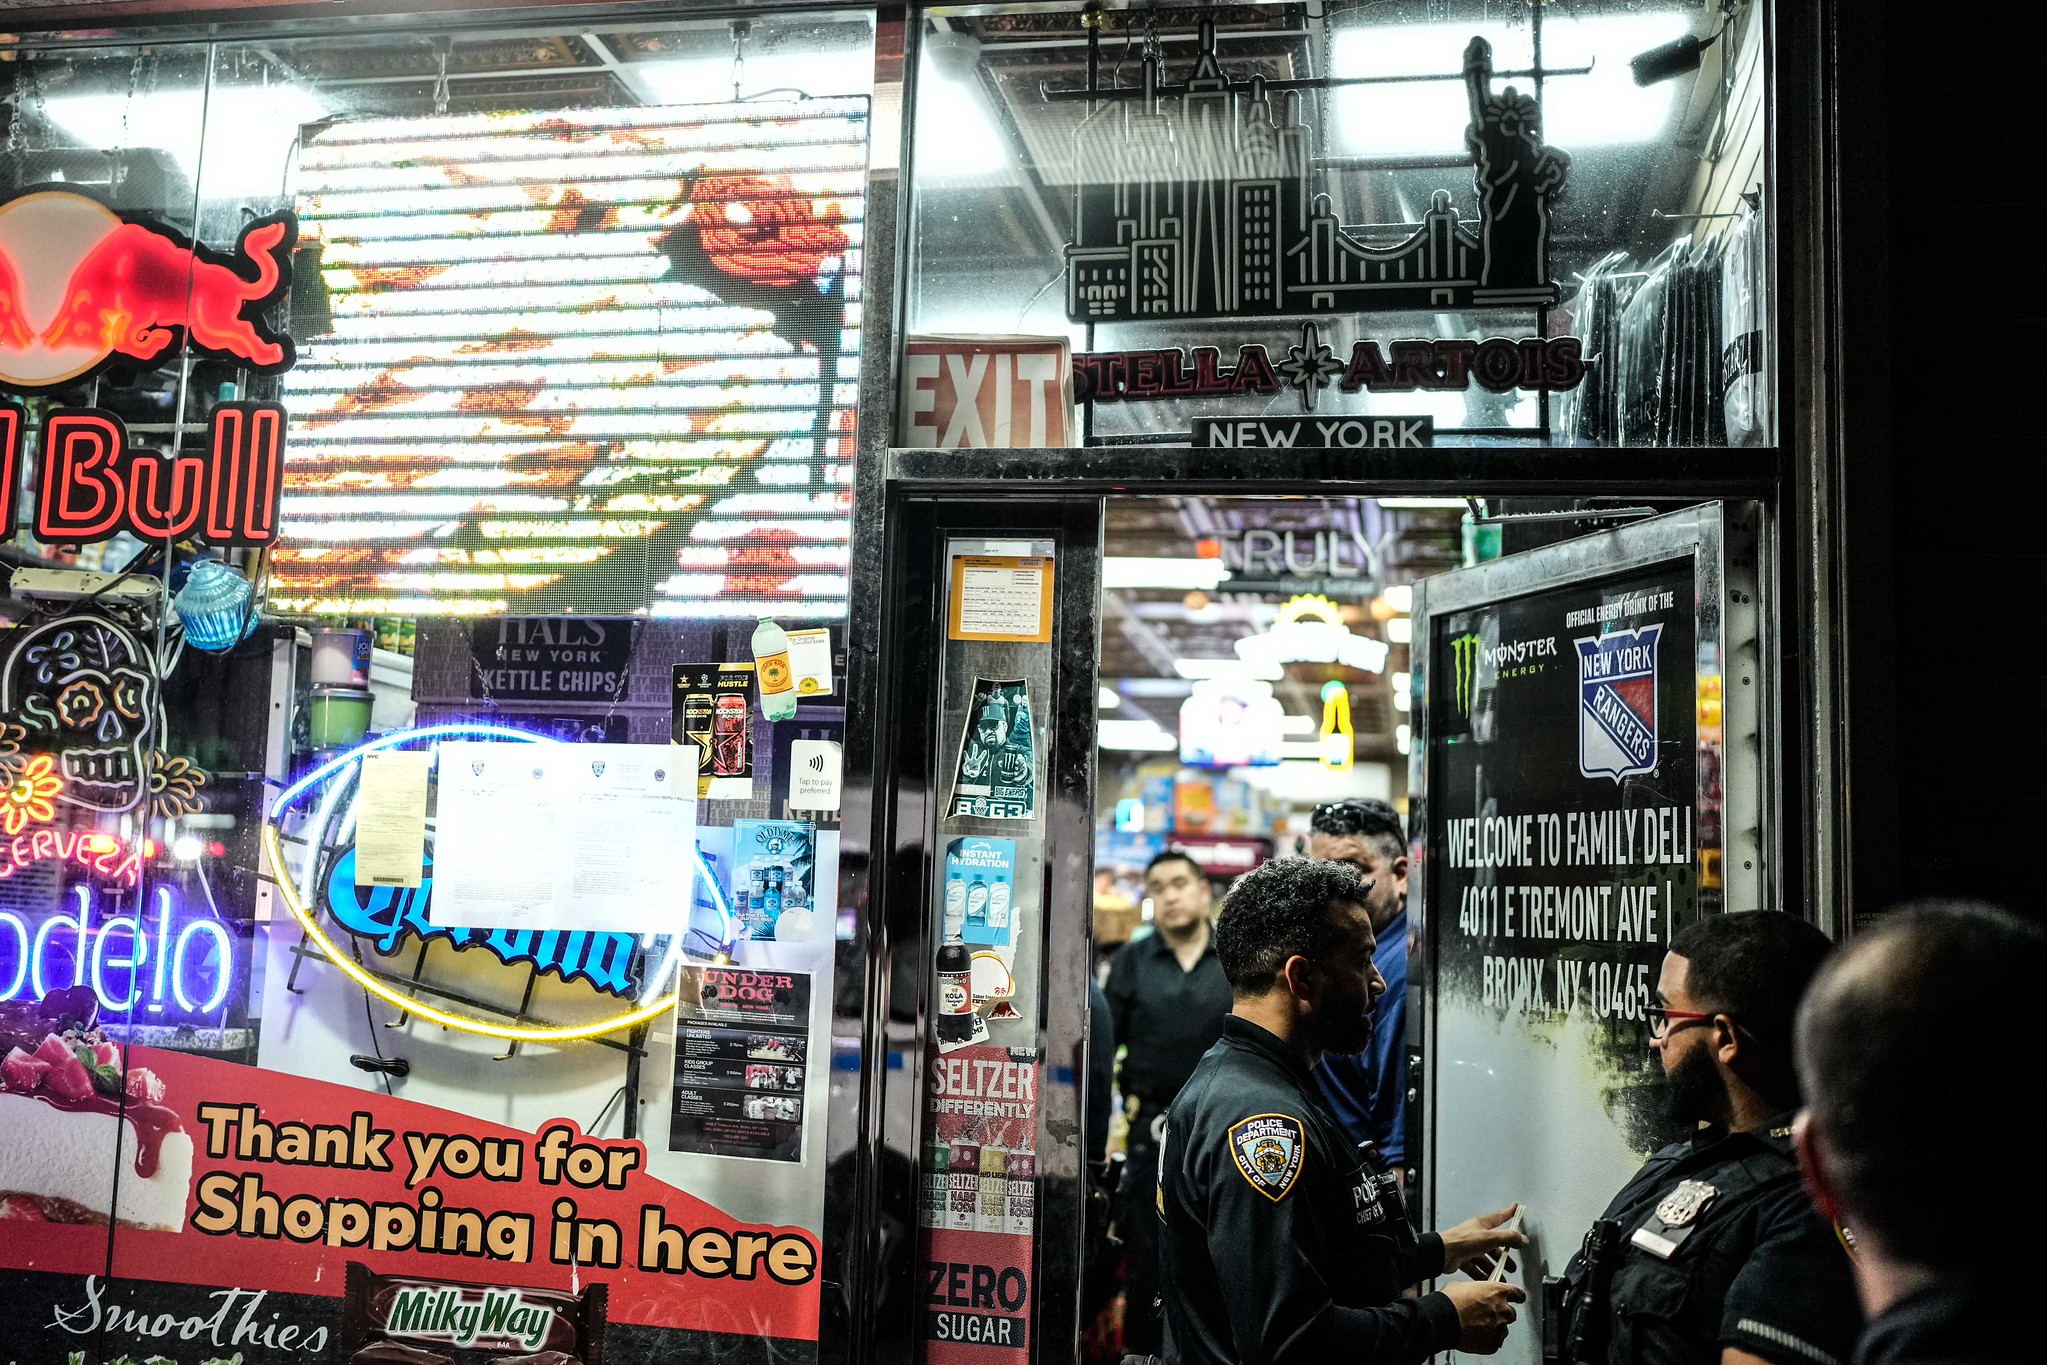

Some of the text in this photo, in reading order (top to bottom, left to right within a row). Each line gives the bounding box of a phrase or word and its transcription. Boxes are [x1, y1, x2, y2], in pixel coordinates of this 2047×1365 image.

[1341, 339, 1586, 392] ARTOIS
[907, 354, 1057, 448] EXIT
[1209, 420, 1424, 447] NEW YORK
[39, 409, 281, 539] Bull
[1205, 530, 1395, 577] TRULY
[1566, 591, 1674, 628] OFFICIAL ENERGY DRINK OF THE
[497, 650, 601, 662] NEW YORK
[1494, 663, 1545, 680] ENERGY
[1584, 645, 1652, 678] NEW YORK
[484, 670, 616, 693] KETTLE CHIPS
[1592, 686, 1650, 760] RANGERS
[798, 778, 810, 786] Tap
[1447, 806, 1691, 868] WELCOME TO FAMILY DELI
[951, 857, 1009, 868] HYDRATION
[960, 849, 1002, 860] INSTANT
[1459, 886, 1498, 937] 4011
[1505, 886, 1515, 937] E
[1519, 886, 1612, 941] TREMONT
[1617, 886, 1658, 943] AVE
[702, 970, 794, 988] UNDER
[718, 985, 775, 1001] DOG
[1557, 960, 1583, 1013] NY
[1588, 962, 1649, 1021] 10465
[1010, 1047, 1037, 1057] NEW
[931, 1058, 1034, 1100] SELTZER
[930, 1099, 1033, 1119] DIFFERENTLY
[1236, 1127, 1297, 1146] DEPARTMENT
[1247, 1119, 1283, 1132] POLICE
[200, 1105, 639, 1187] Thank you for
[1239, 1155, 1266, 1187] CITY OF
[1279, 1144, 1302, 1190] NEW YORK
[195, 1174, 815, 1283] Shopping in here
[928, 1261, 1027, 1313] ZERO
[44, 1274, 329, 1352] Smoothies
[937, 1313, 1011, 1344] SUGAR
[496, 1341, 511, 1349] BAR
